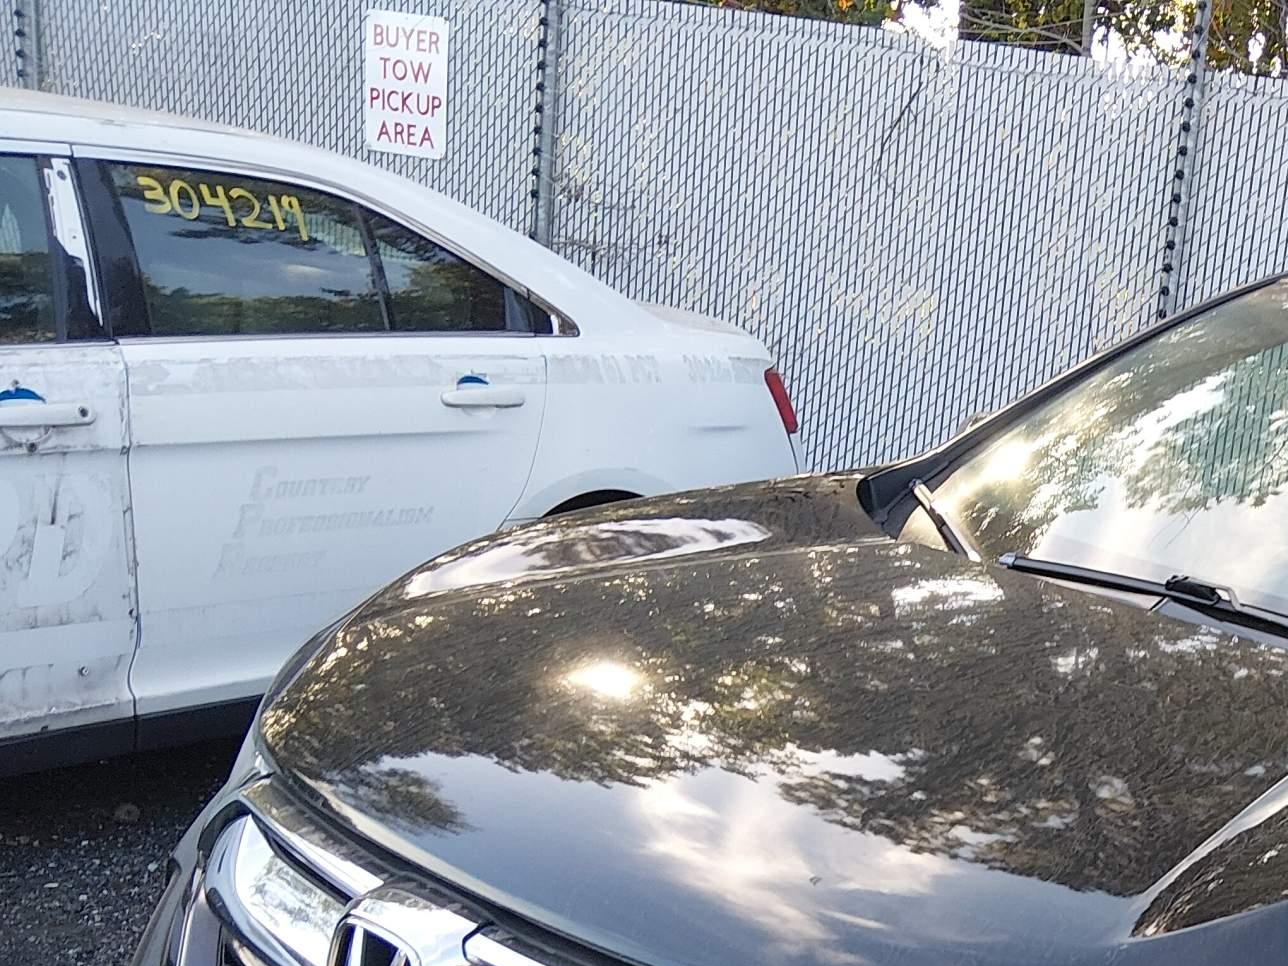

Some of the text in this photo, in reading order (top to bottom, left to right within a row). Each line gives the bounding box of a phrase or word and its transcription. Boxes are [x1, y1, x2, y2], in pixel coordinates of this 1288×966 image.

[373, 24, 440, 54] BUYER
[379, 57, 432, 84] TOW
[369, 87, 442, 118] PICKUP
[376, 120, 434, 149] AREA
[137, 176, 309, 241] 304219
